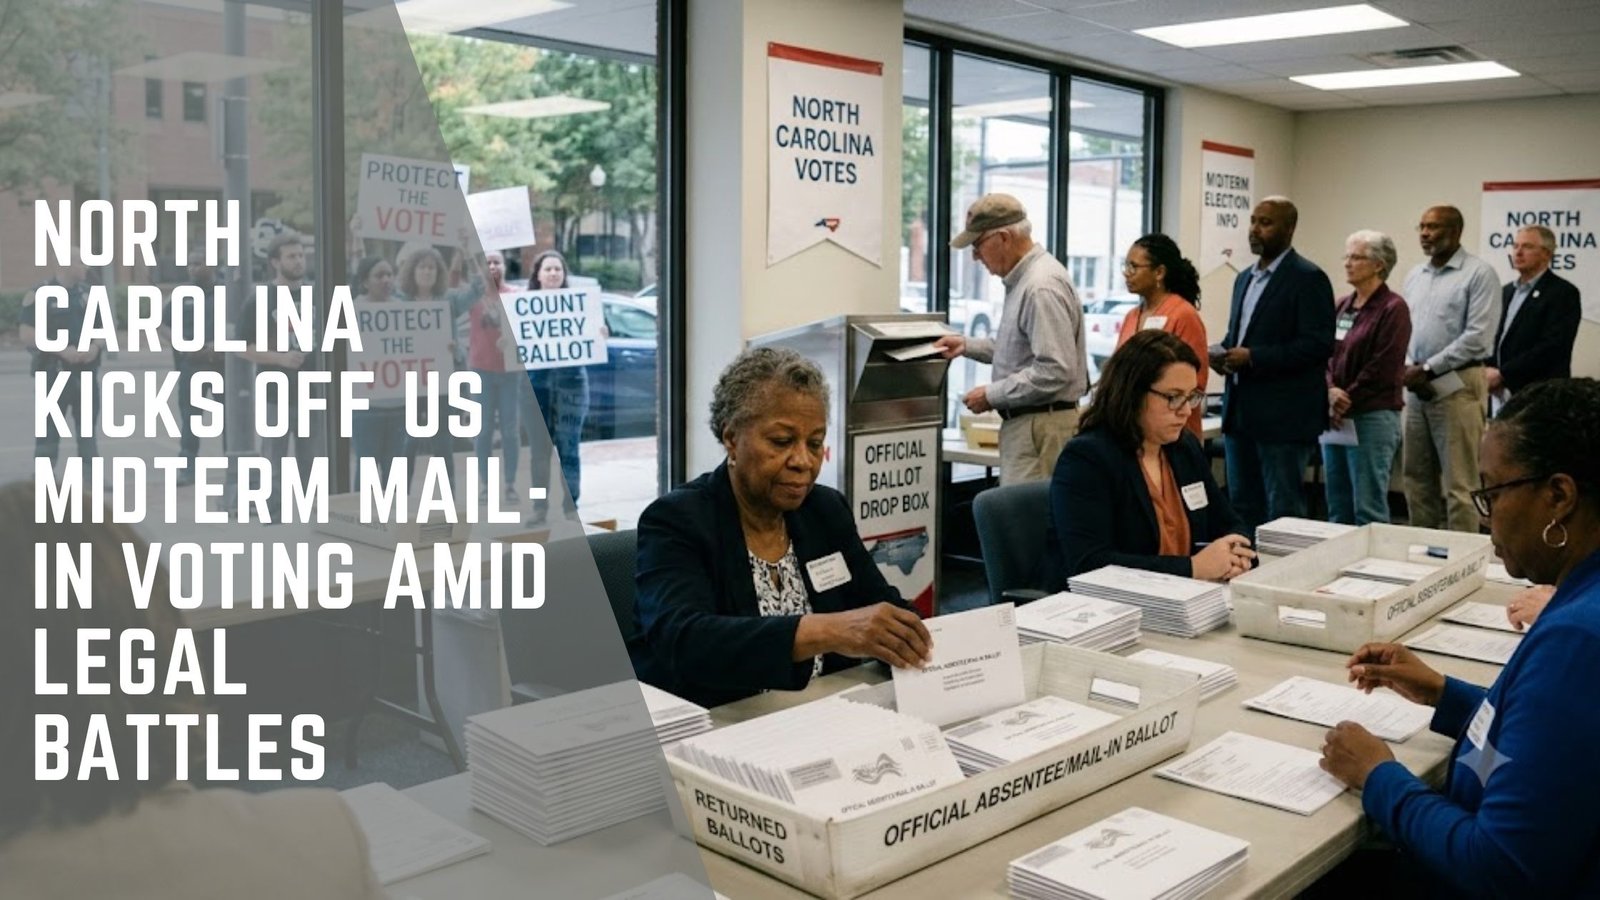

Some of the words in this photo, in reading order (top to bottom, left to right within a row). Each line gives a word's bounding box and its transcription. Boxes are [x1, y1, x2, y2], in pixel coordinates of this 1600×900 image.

[793, 95, 859, 125] NORTH
[776, 124, 874, 156] CAROLINA
[367, 161, 463, 190] PROTECT
[794, 157, 857, 184] VOTES
[399, 188, 429, 206] THE
[376, 206, 446, 236] VOTE
[1507, 210, 1580, 227] NORTH
[1490, 232, 1597, 249] CAINA
[515, 293, 587, 316] COUNT
[359, 308, 444, 333] ROTECT
[520, 317, 586, 340] EVERY
[381, 336, 414, 354] THE
[516, 340, 594, 364] BALLOT
[865, 440, 926, 464] OFFICIAL
[870, 466, 922, 491] BALLOT
[860, 497, 898, 519] DROP
[902, 491, 929, 513] BOX
[884, 798, 970, 847] OFFICIAL
[975, 735, 1122, 813] ABSENTEE/MAIL-IN
[1124, 710, 1178, 750] BALLOT
[695, 788, 787, 840] RETURNED
[706, 817, 785, 864] BALLOTS
